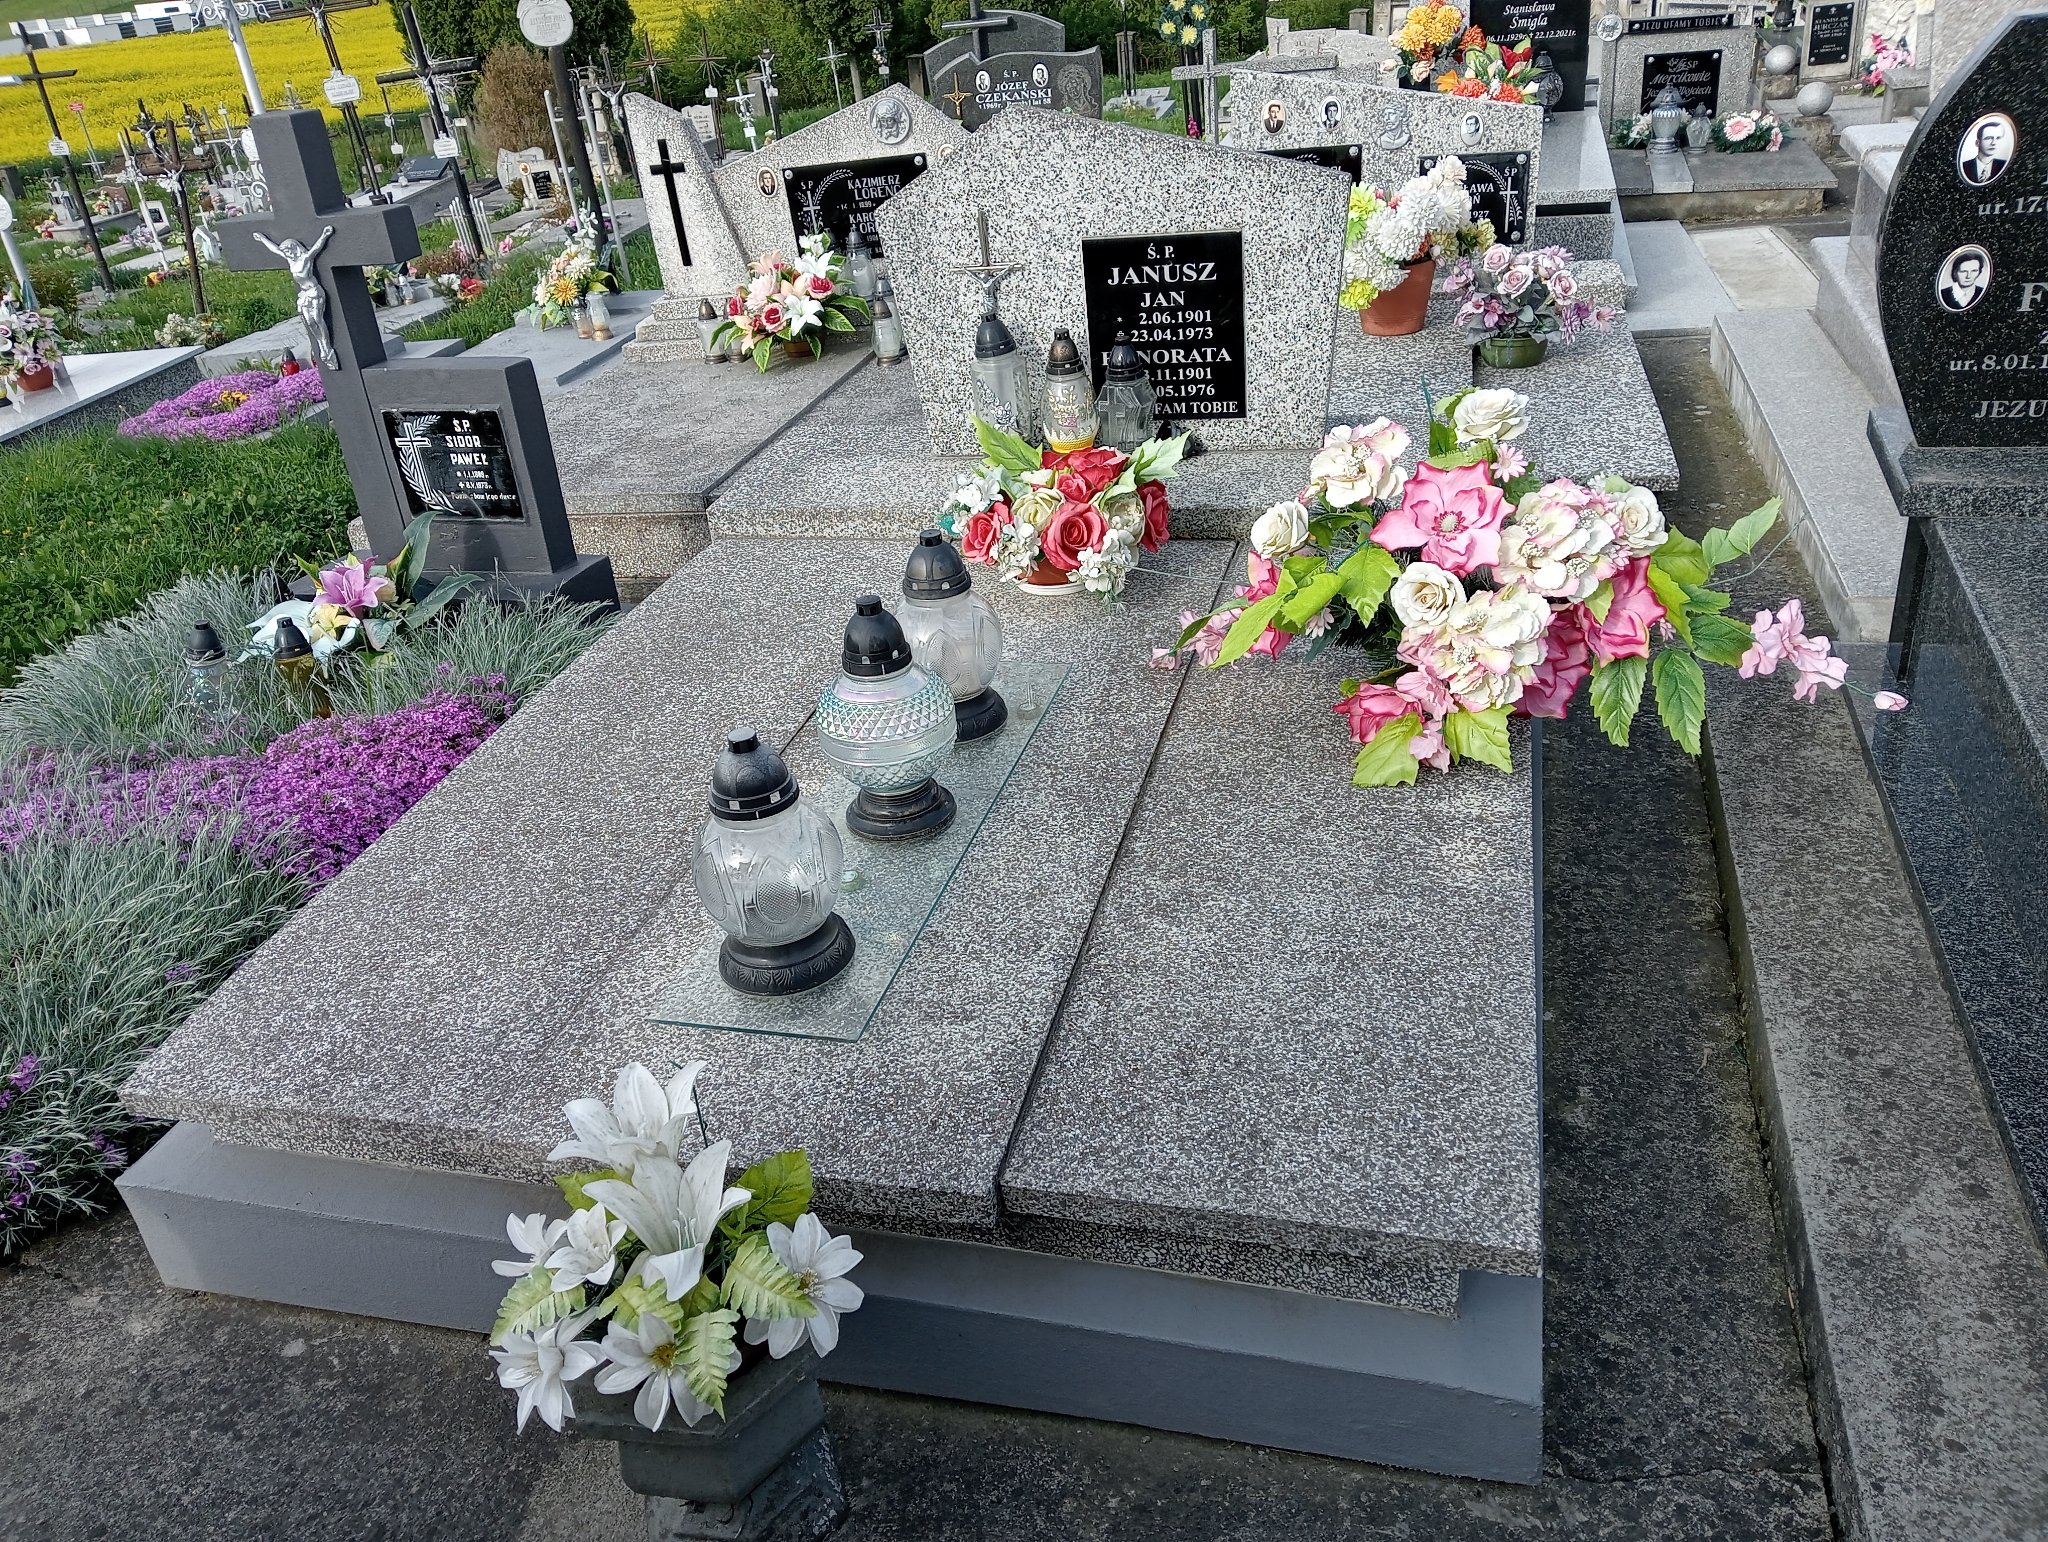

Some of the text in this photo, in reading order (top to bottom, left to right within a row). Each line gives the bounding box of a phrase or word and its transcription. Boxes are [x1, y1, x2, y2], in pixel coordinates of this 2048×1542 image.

[1503, 1, 1556, 16] Stanisława
[1641, 20, 1661, 31] JEZU
[1663, 19, 1692, 29] UFAMY
[994, 80, 1029, 92] JÓZEF
[975, 88, 1053, 104] CZEKAŃSKI
[847, 174, 901, 190] KAZIMIERZ
[1978, 195, 2048, 216] ur. 17.
[1148, 243, 1175, 259] Ś. P.
[1107, 262, 1217, 286] JANUSZ
[1140, 290, 1186, 308] JAN
[1138, 309, 1213, 325] 2.06.1901
[1131, 326, 1214, 342] 23.04.1973
[1950, 354, 2048, 371] ur. 8.01.1
[1189, 401, 1239, 414] TOBIE
[1974, 400, 2048, 419] JEZU
[446, 435, 482, 448] SIDOR
[450, 452, 489, 466] PAWEŁ
